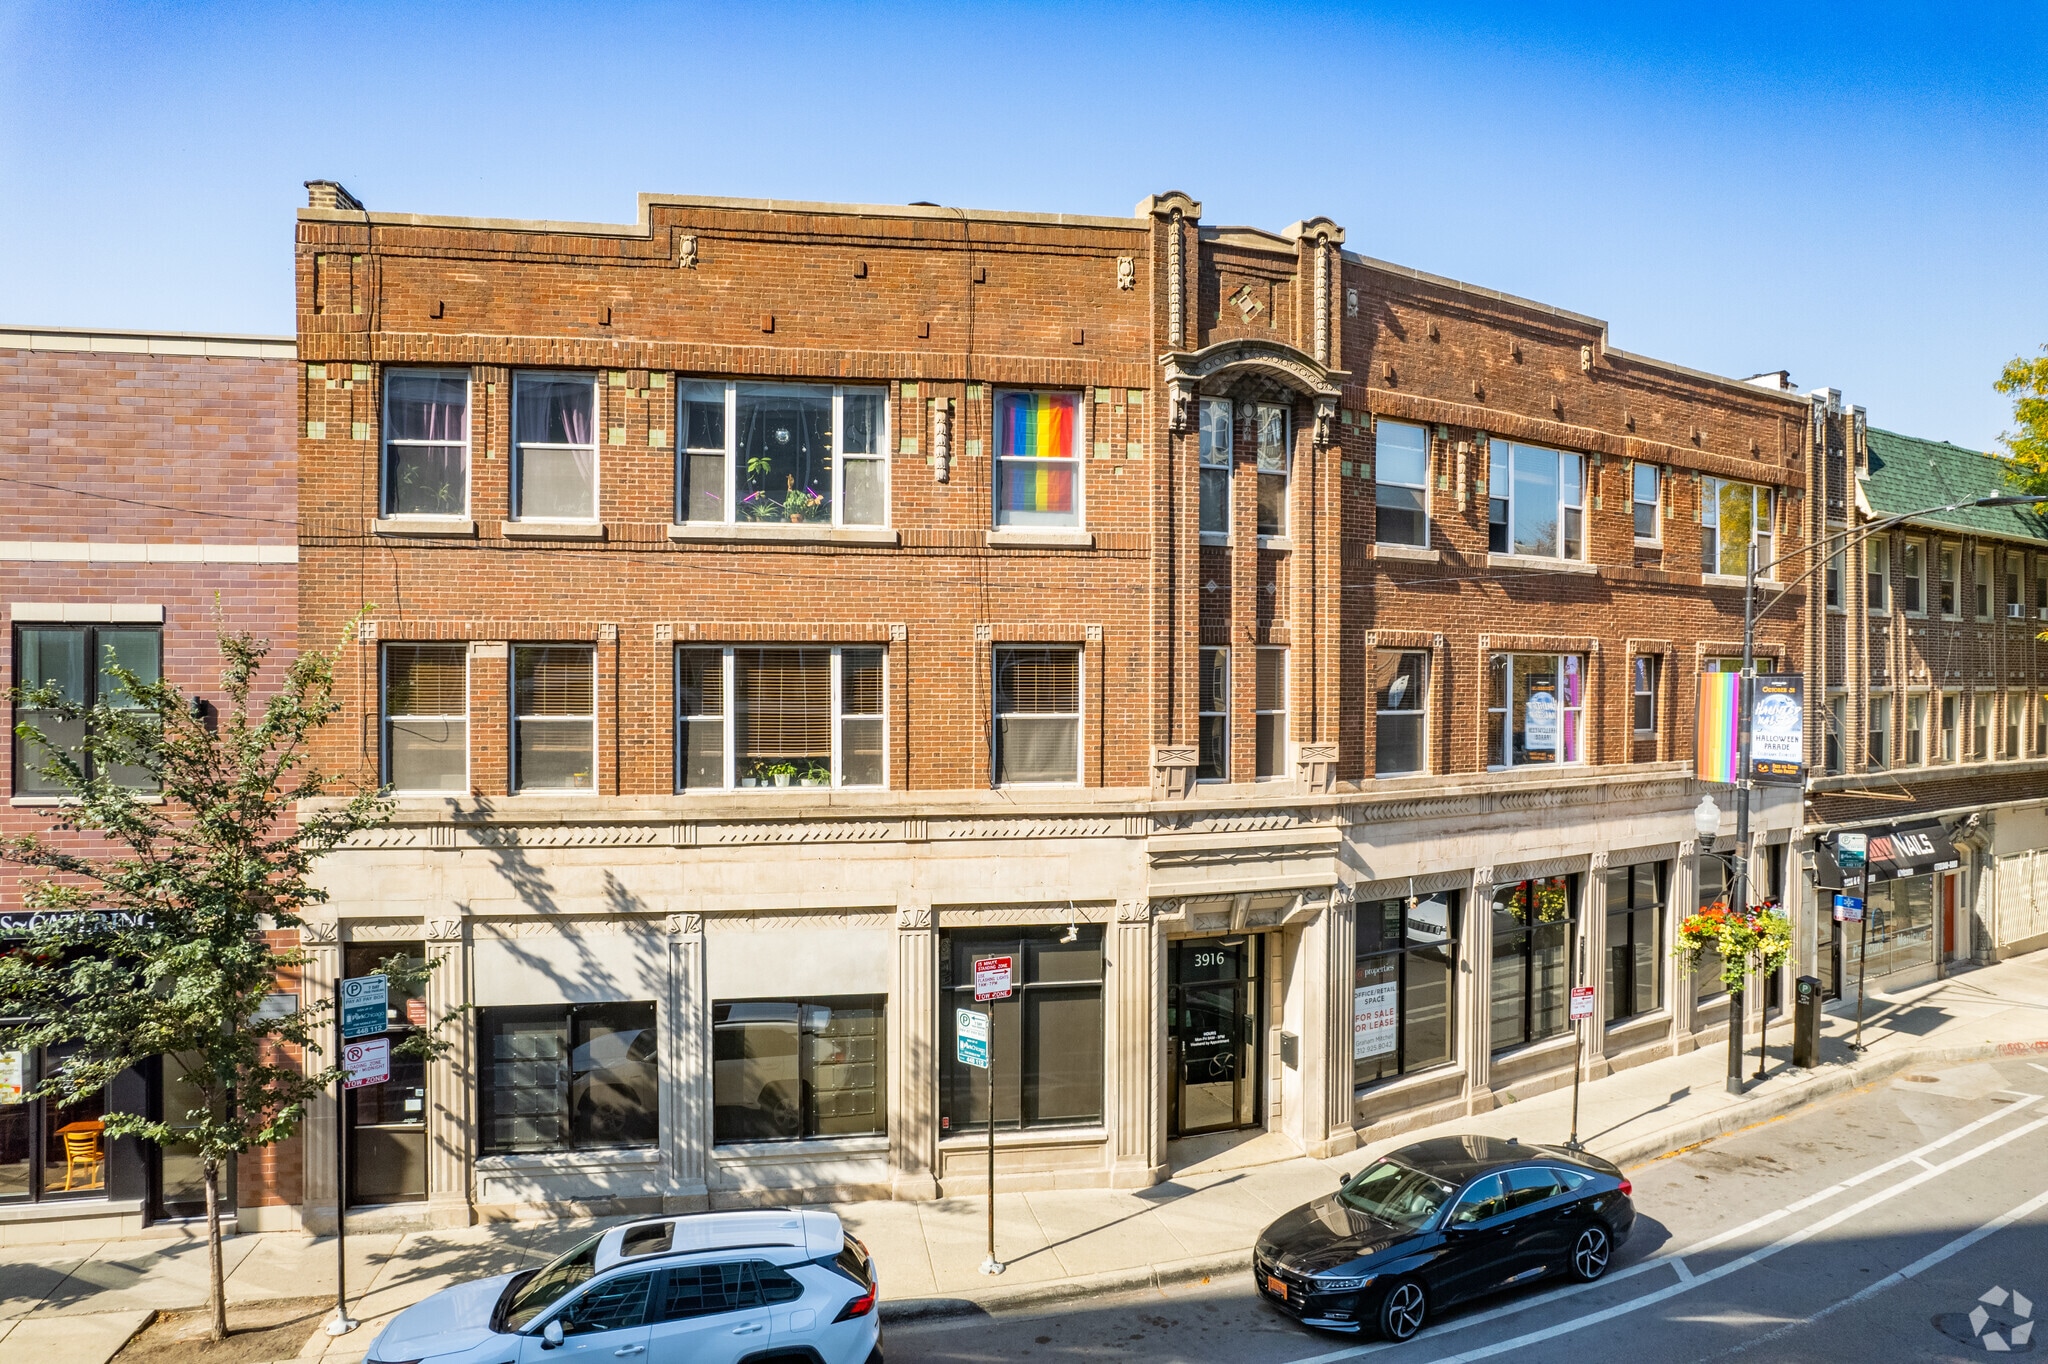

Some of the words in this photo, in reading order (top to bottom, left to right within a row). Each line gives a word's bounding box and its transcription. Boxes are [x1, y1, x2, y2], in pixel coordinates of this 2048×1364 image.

[1756, 734, 1799, 743] HALLOWEEN
[1890, 832, 1936, 858] NAILS
[1897, 931, 1926, 946] Manicure
[1853, 942, 1884, 958] Peicure
[1194, 952, 1224, 967] 3916
[1355, 986, 1395, 999] OFFICE/RETAIL
[1364, 995, 1385, 1005] SPACE
[352, 1011, 384, 1020] ParkChicago
[1355, 1012, 1372, 1023] FOR
[1374, 1008, 1394, 1019] SALE
[1355, 1024, 1367, 1032] OR
[1369, 1018, 1394, 1029] LEASE
[1356, 1037, 1374, 1047] Graham
[1376, 1033, 1394, 1043] Mitchell
